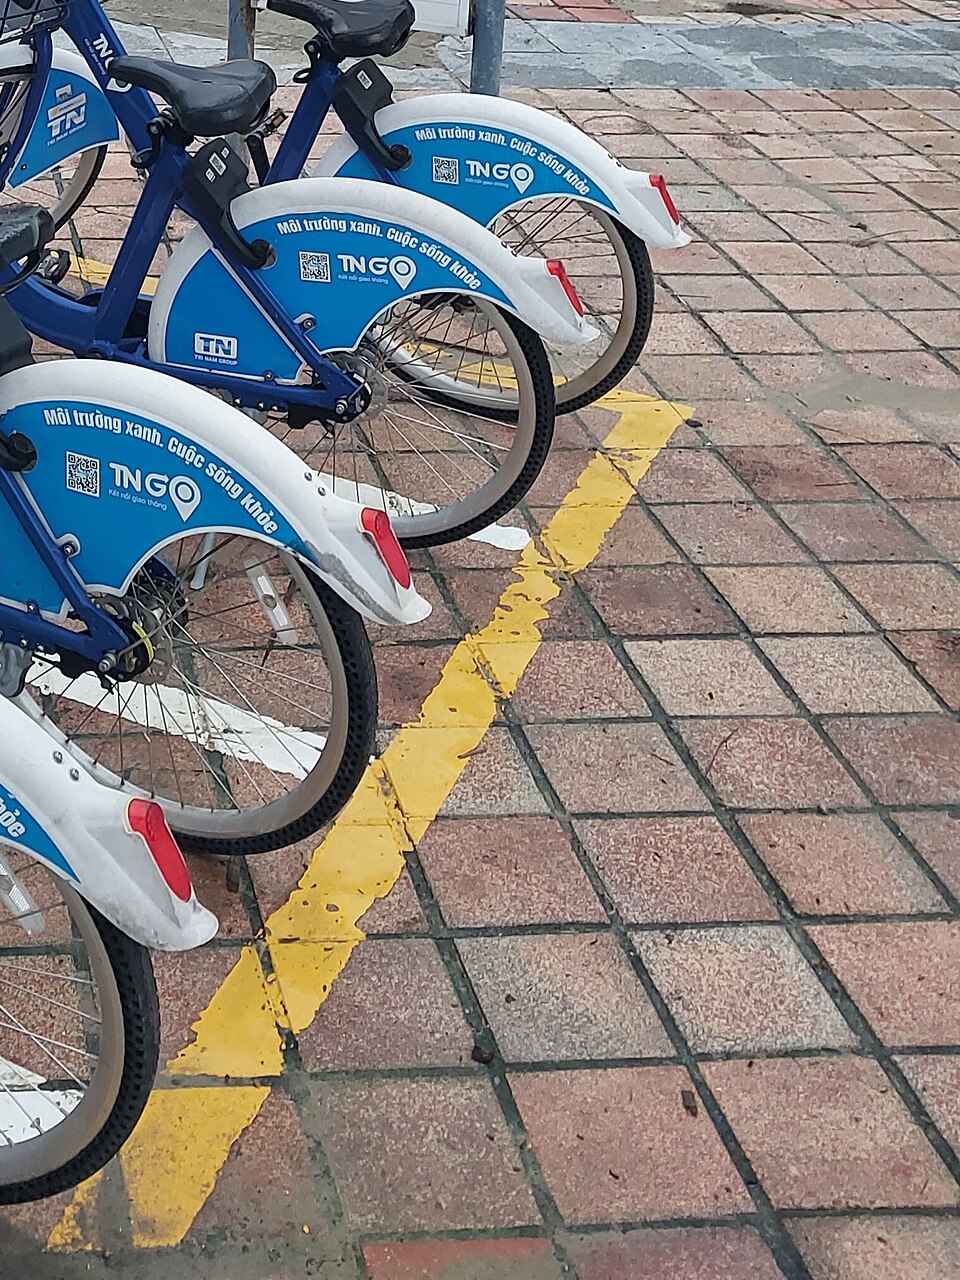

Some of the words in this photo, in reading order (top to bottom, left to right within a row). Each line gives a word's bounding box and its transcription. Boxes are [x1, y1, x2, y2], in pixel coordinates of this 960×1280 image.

[47, 106, 86, 137] TN
[415, 126, 436, 141] Môi
[438, 125, 476, 141] trường
[477, 131, 507, 147] xanh.
[510, 137, 537, 157] Cuộc
[537, 151, 567, 175] sống
[562, 168, 591, 196] khỏe
[276, 218, 302, 235] Môi
[303, 216, 347, 233] trường
[349, 220, 384, 238] xanh.
[386, 227, 418, 248] Cuộc
[418, 241, 452, 267] sống
[448, 259, 482, 290] khỏe
[198, 335, 232, 356] TN
[43, 407, 72, 427] Môi
[73, 408, 122, 434] trường
[125, 420, 164, 448] xanh.
[167, 436, 206, 468] Cuộc
[205, 461, 244, 499] sống
[240, 492, 279, 534] khỏe
